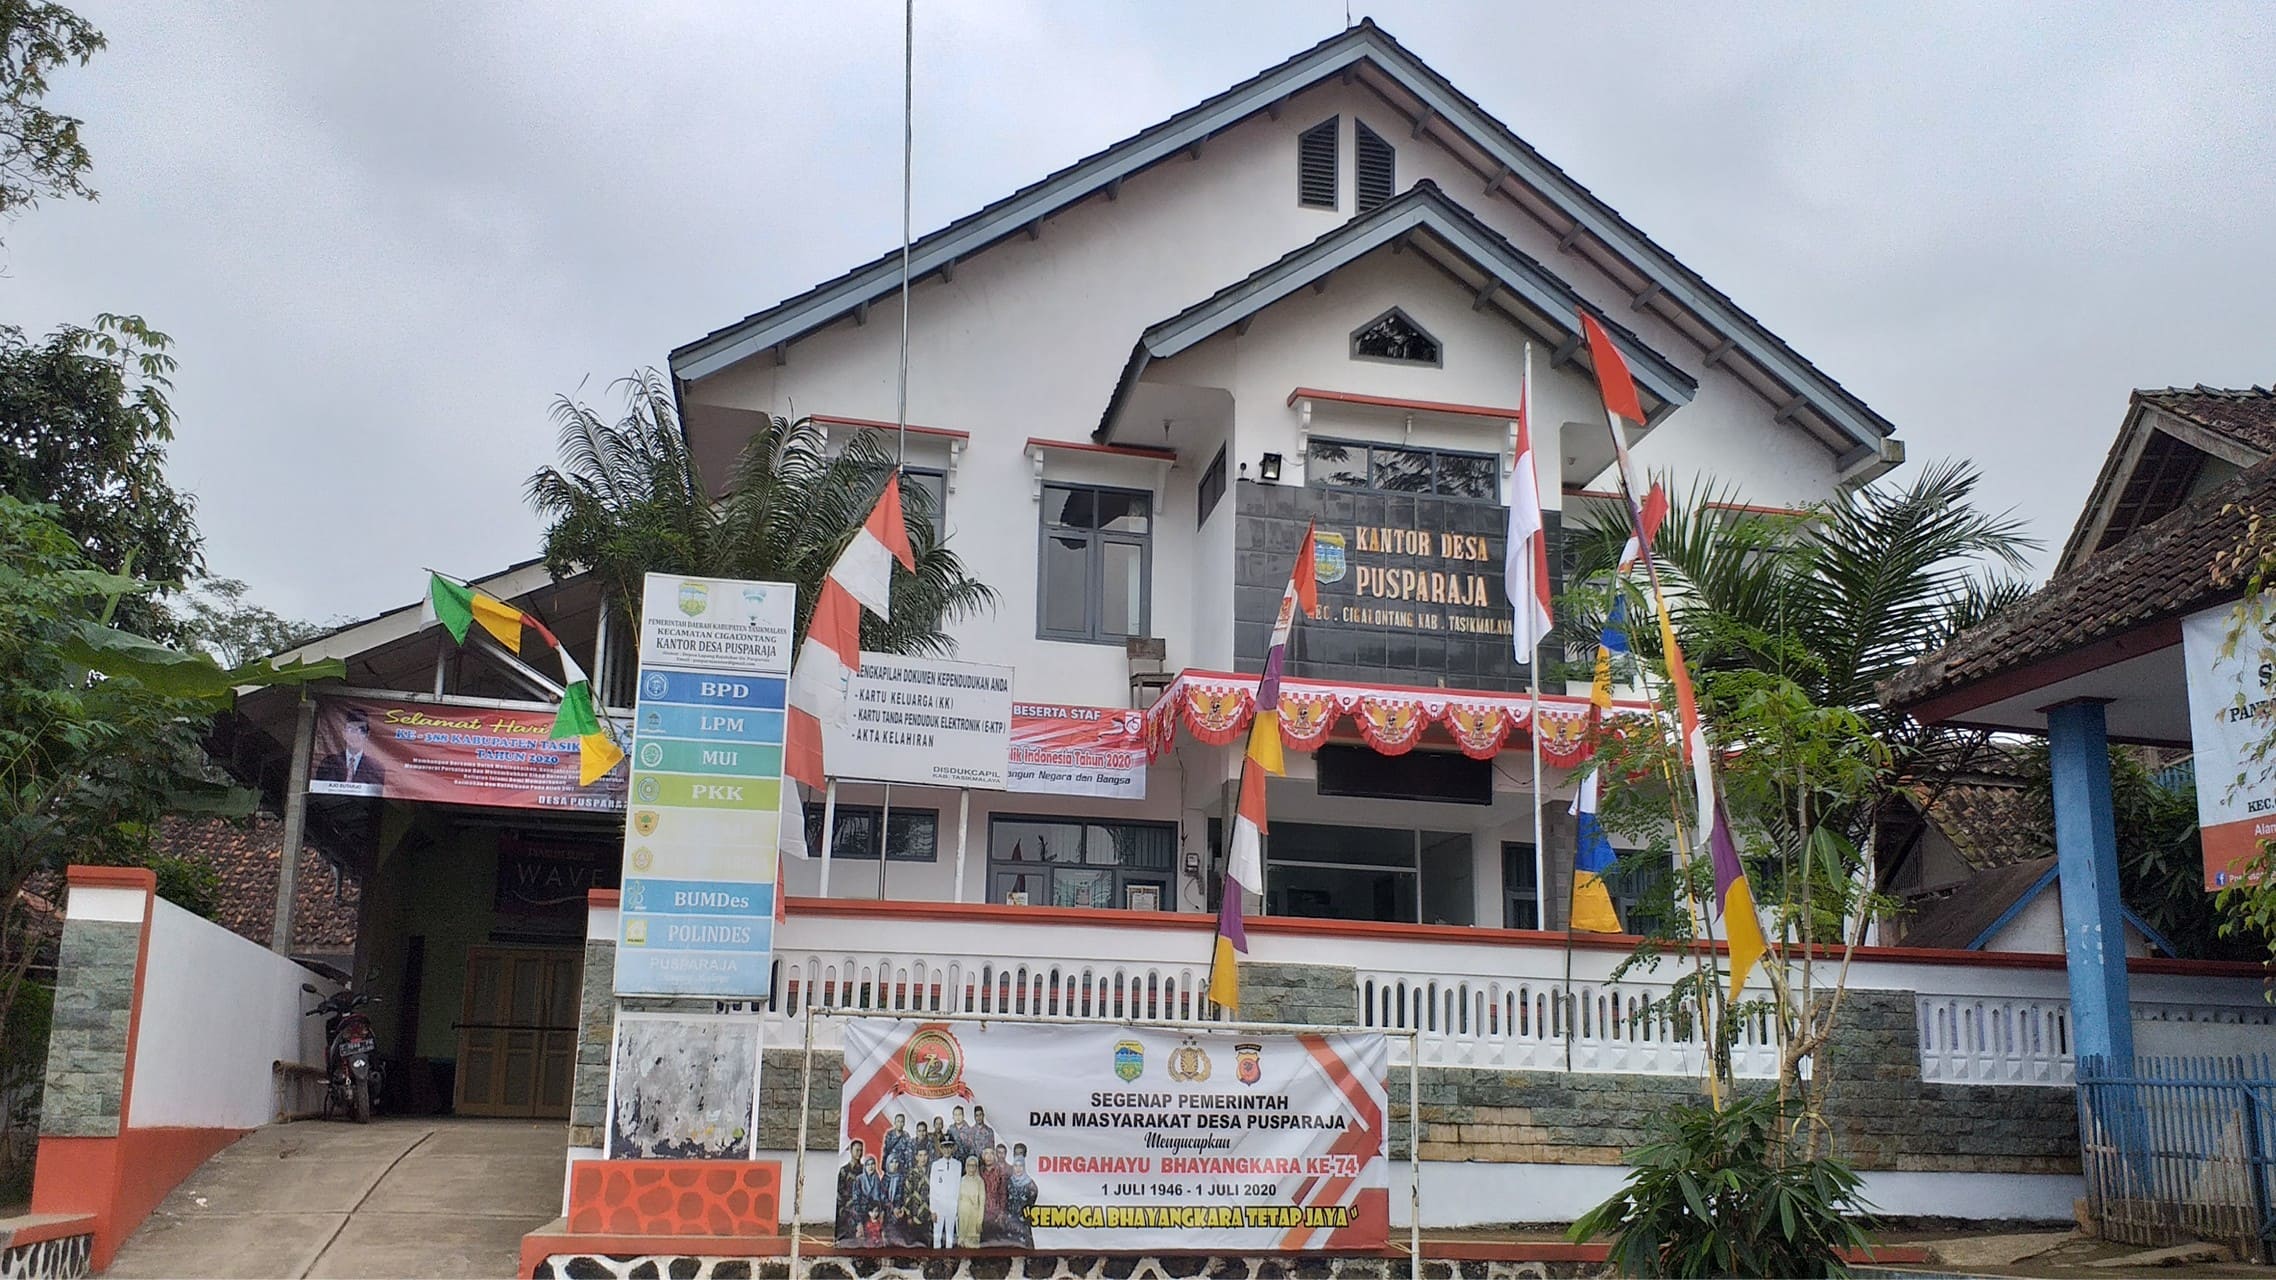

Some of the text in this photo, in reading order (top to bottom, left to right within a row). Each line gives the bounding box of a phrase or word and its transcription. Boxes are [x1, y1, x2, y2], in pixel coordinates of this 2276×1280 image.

[1356, 526, 1489, 561] KANTOR DESA
[1356, 566, 1488, 607] PUSPARAJA
[648, 618, 787, 634] PEMERINTAH DAERAH KABUPATEN TASIKMALAYA
[1342, 606, 1414, 628] CIGALONTANG
[1448, 616, 1513, 635] TASIKMALAYA
[657, 628, 777, 643] KECAMATAN CIGALONTANG
[656, 638, 696, 650] KANTOR
[698, 640, 723, 653] DESA
[725, 643, 777, 658] PUSPARAJA
[903, 668, 936, 685] DOKUMEN
[937, 672, 989, 691] KEPENDUDUKAN
[990, 677, 1008, 692] ANDA
[701, 681, 749, 698] BPD
[859, 689, 887, 703] KARTU
[890, 692, 933, 707] KELUARGA
[935, 697, 954, 710] (KK)
[384, 709, 549, 734] Selamat Hari
[858, 708, 881, 722] KARTU
[882, 710, 903, 724] TANDA
[904, 713, 939, 728] PENDUDUK
[941, 716, 981, 732] ELEKTRONIK
[981, 720, 1006, 734] (E-KTP)
[1013, 705, 1101, 720] BESERTA STAF
[700, 716, 745, 732] LPM
[395, 729, 416, 740] KE
[424, 733, 448, 743] 388
[450, 733, 537, 749] KABUPATEN
[856, 728, 880, 743] AKTA
[882, 731, 934, 747] KELAHIRAN
[476, 749, 559, 765] TAHUN 2020
[703, 751, 738, 766] MUI
[1010, 746, 1131, 769] lik Indonesia Tahun 2020
[933, 766, 1000, 778] DISDUKCAPIL
[951, 775, 1001, 784] TASIKMALAYA
[1008, 771, 1131, 785] angun Negara dan Bangsa
[538, 795, 567, 805] DESA
[691, 784, 744, 801] PKK
[518, 862, 605, 888] WAVE
[674, 891, 749, 908] BUMDes
[668, 925, 751, 943] POLINDES
[650, 957, 737, 972] PUSPARAJA
[1091, 1092, 1288, 1110] SEGENAP PEMERINTAH
[1029, 1112, 1346, 1130] DAN MASYARAKAT DESA PUSPARAJA
[1143, 1132, 1231, 1155] Mengucapkan
[1037, 1156, 1358, 1175] DIRGAHAYU BHAYANGKARA KE-74
[1101, 1184, 1108, 1195] 1
[1113, 1184, 1145, 1196] JULI
[1150, 1184, 1183, 1196] 1946
[1195, 1184, 1202, 1196] 1
[1207, 1184, 1239, 1197] JULI
[1244, 1184, 1277, 1197] 2020
[1107, 1205, 1245, 1229] BHAYANGKARA
[1245, 1206, 1302, 1228] TETAP
